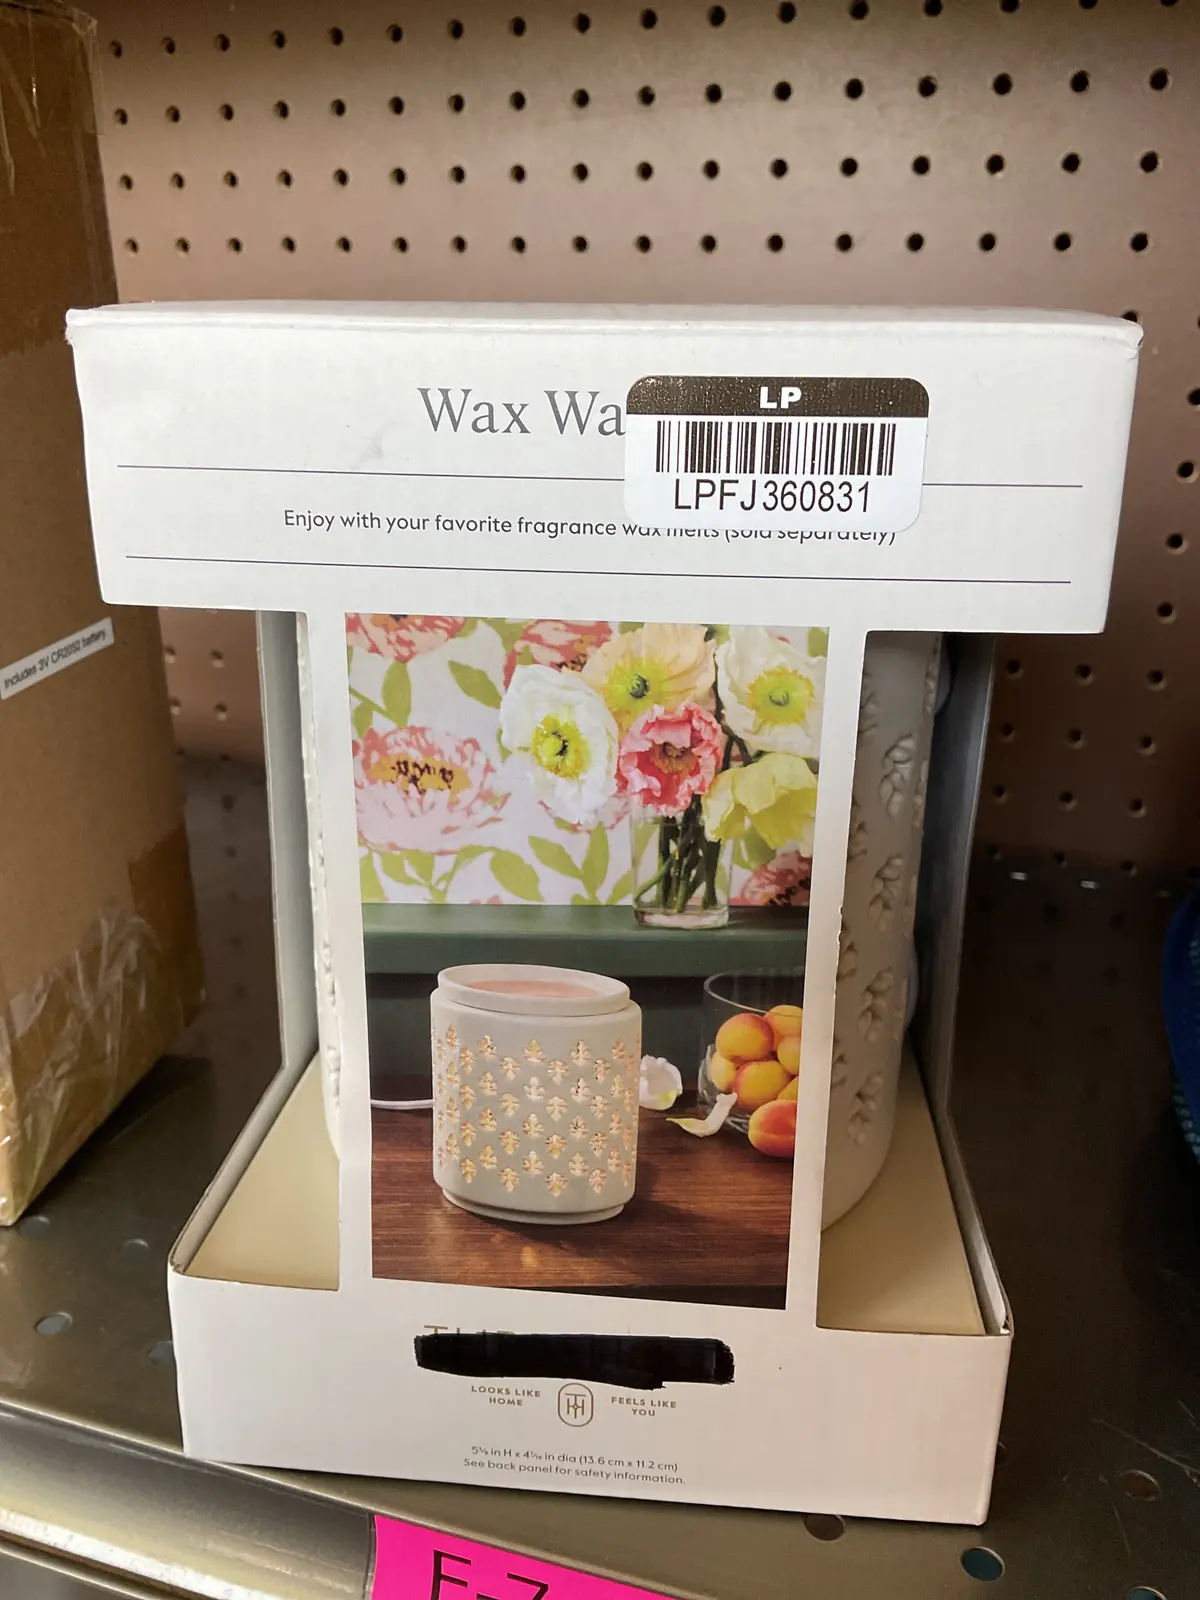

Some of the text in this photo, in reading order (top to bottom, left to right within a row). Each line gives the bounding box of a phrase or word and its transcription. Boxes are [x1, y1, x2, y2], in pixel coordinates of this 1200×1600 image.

[759, 386, 802, 410] LP
[417, 386, 531, 435] Wax
[673, 478, 871, 513] LPFJ360831
[283, 509, 335, 532] Enjoy
[340, 511, 382, 530] with
[386, 516, 430, 534] your
[435, 514, 513, 533] favorite
[517, 516, 617, 539] fragrance
[622, 523, 661, 537] wax
[471, 1385, 541, 1398] LOOKS LIKE
[489, 1397, 523, 1407] HOME
[611, 1396, 677, 1409] FEELS LIKE
[632, 1408, 656, 1417] YOU
[463, 1457, 686, 1485] See back panel for safety information.
[491, 1448, 501, 1457] in
[503, 1448, 512, 1458] H
[544, 1452, 555, 1461] in
[557, 1453, 577, 1464] dia
[607, 1458, 625, 1467] cm
[636, 1460, 656, 1470] 11.2
[657, 1462, 678, 1473] cm)
